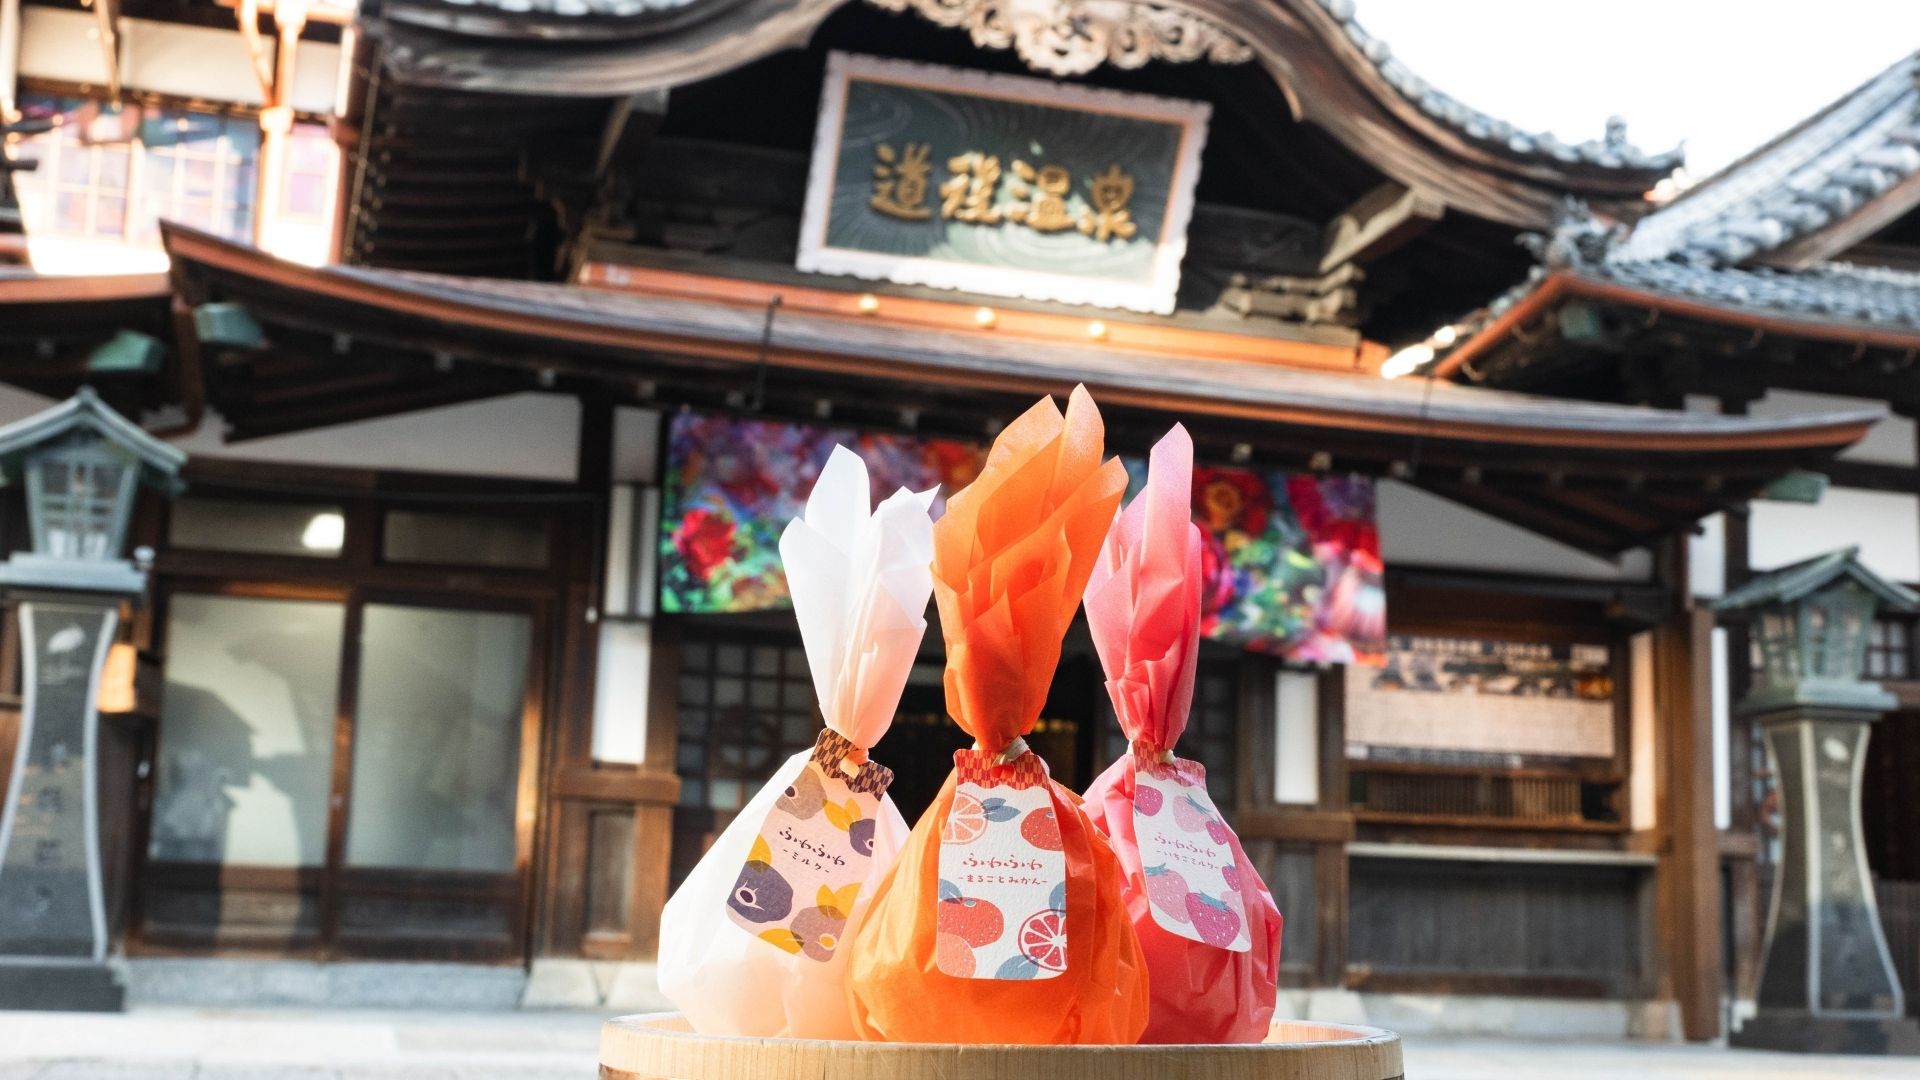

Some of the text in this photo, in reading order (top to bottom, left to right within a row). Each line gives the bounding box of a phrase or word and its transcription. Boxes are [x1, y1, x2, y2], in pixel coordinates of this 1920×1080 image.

[779, 827, 846, 866] ふわふわ
[1154, 832, 1216, 858] ふわふわ
[963, 852, 1043, 870] ふわふわ
